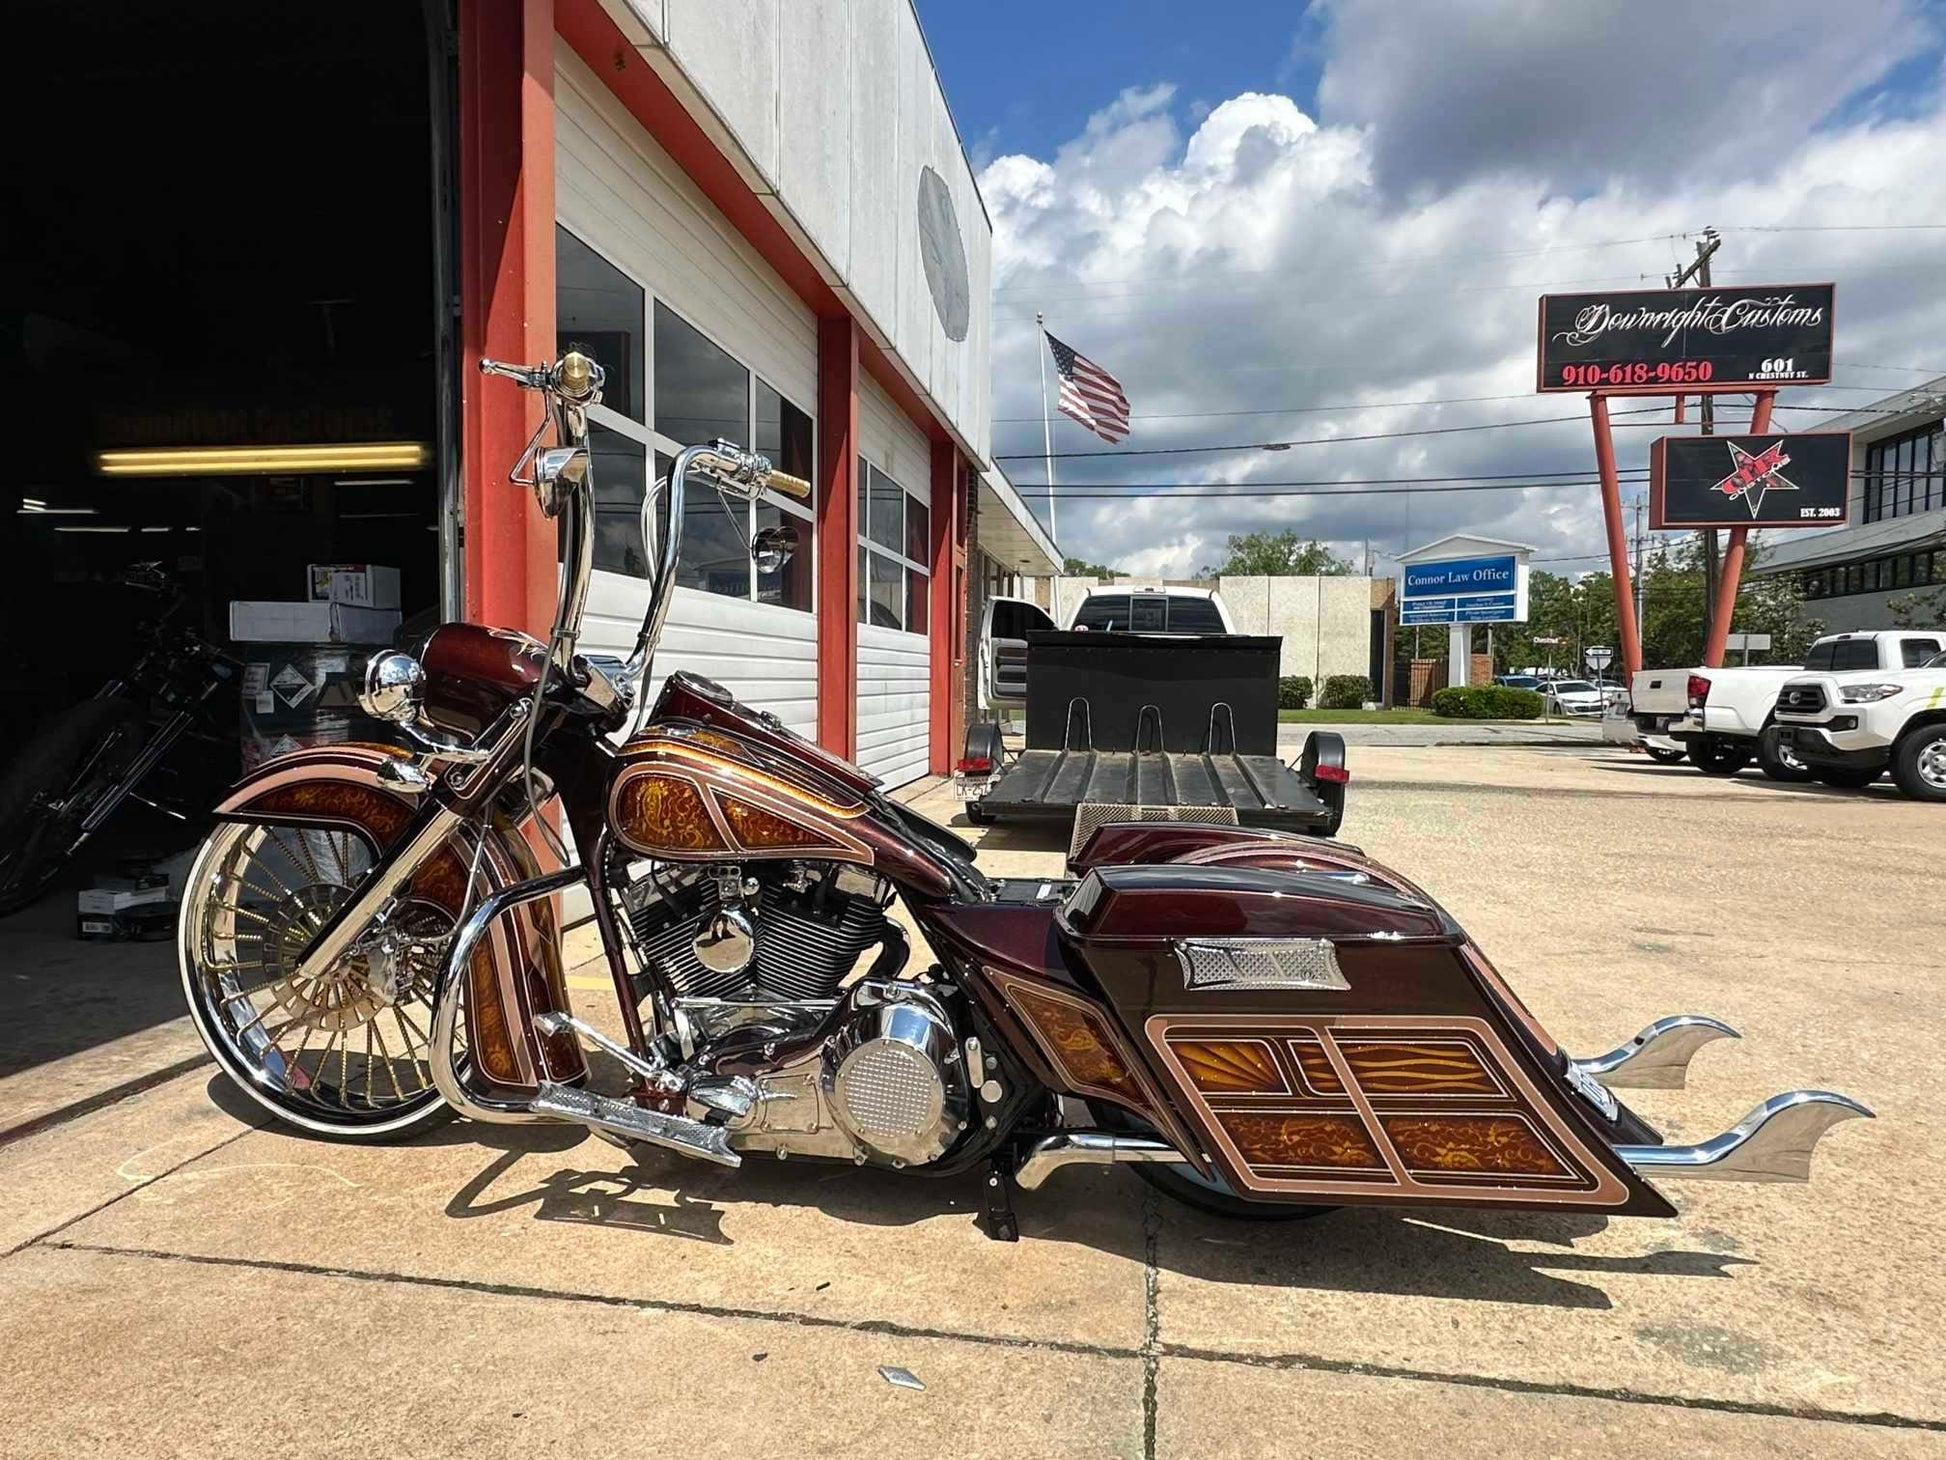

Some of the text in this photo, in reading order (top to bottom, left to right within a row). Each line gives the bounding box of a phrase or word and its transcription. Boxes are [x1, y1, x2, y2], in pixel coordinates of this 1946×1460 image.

[1552, 294, 1823, 348] Downright Customs
[1562, 361, 1713, 386] 910-618-9650
[1761, 358, 1794, 373] 601
[1755, 371, 1796, 380] CHESTNUT
[1800, 507, 1817, 518] EST.
[1407, 567, 1510, 586] Connor Law Office
